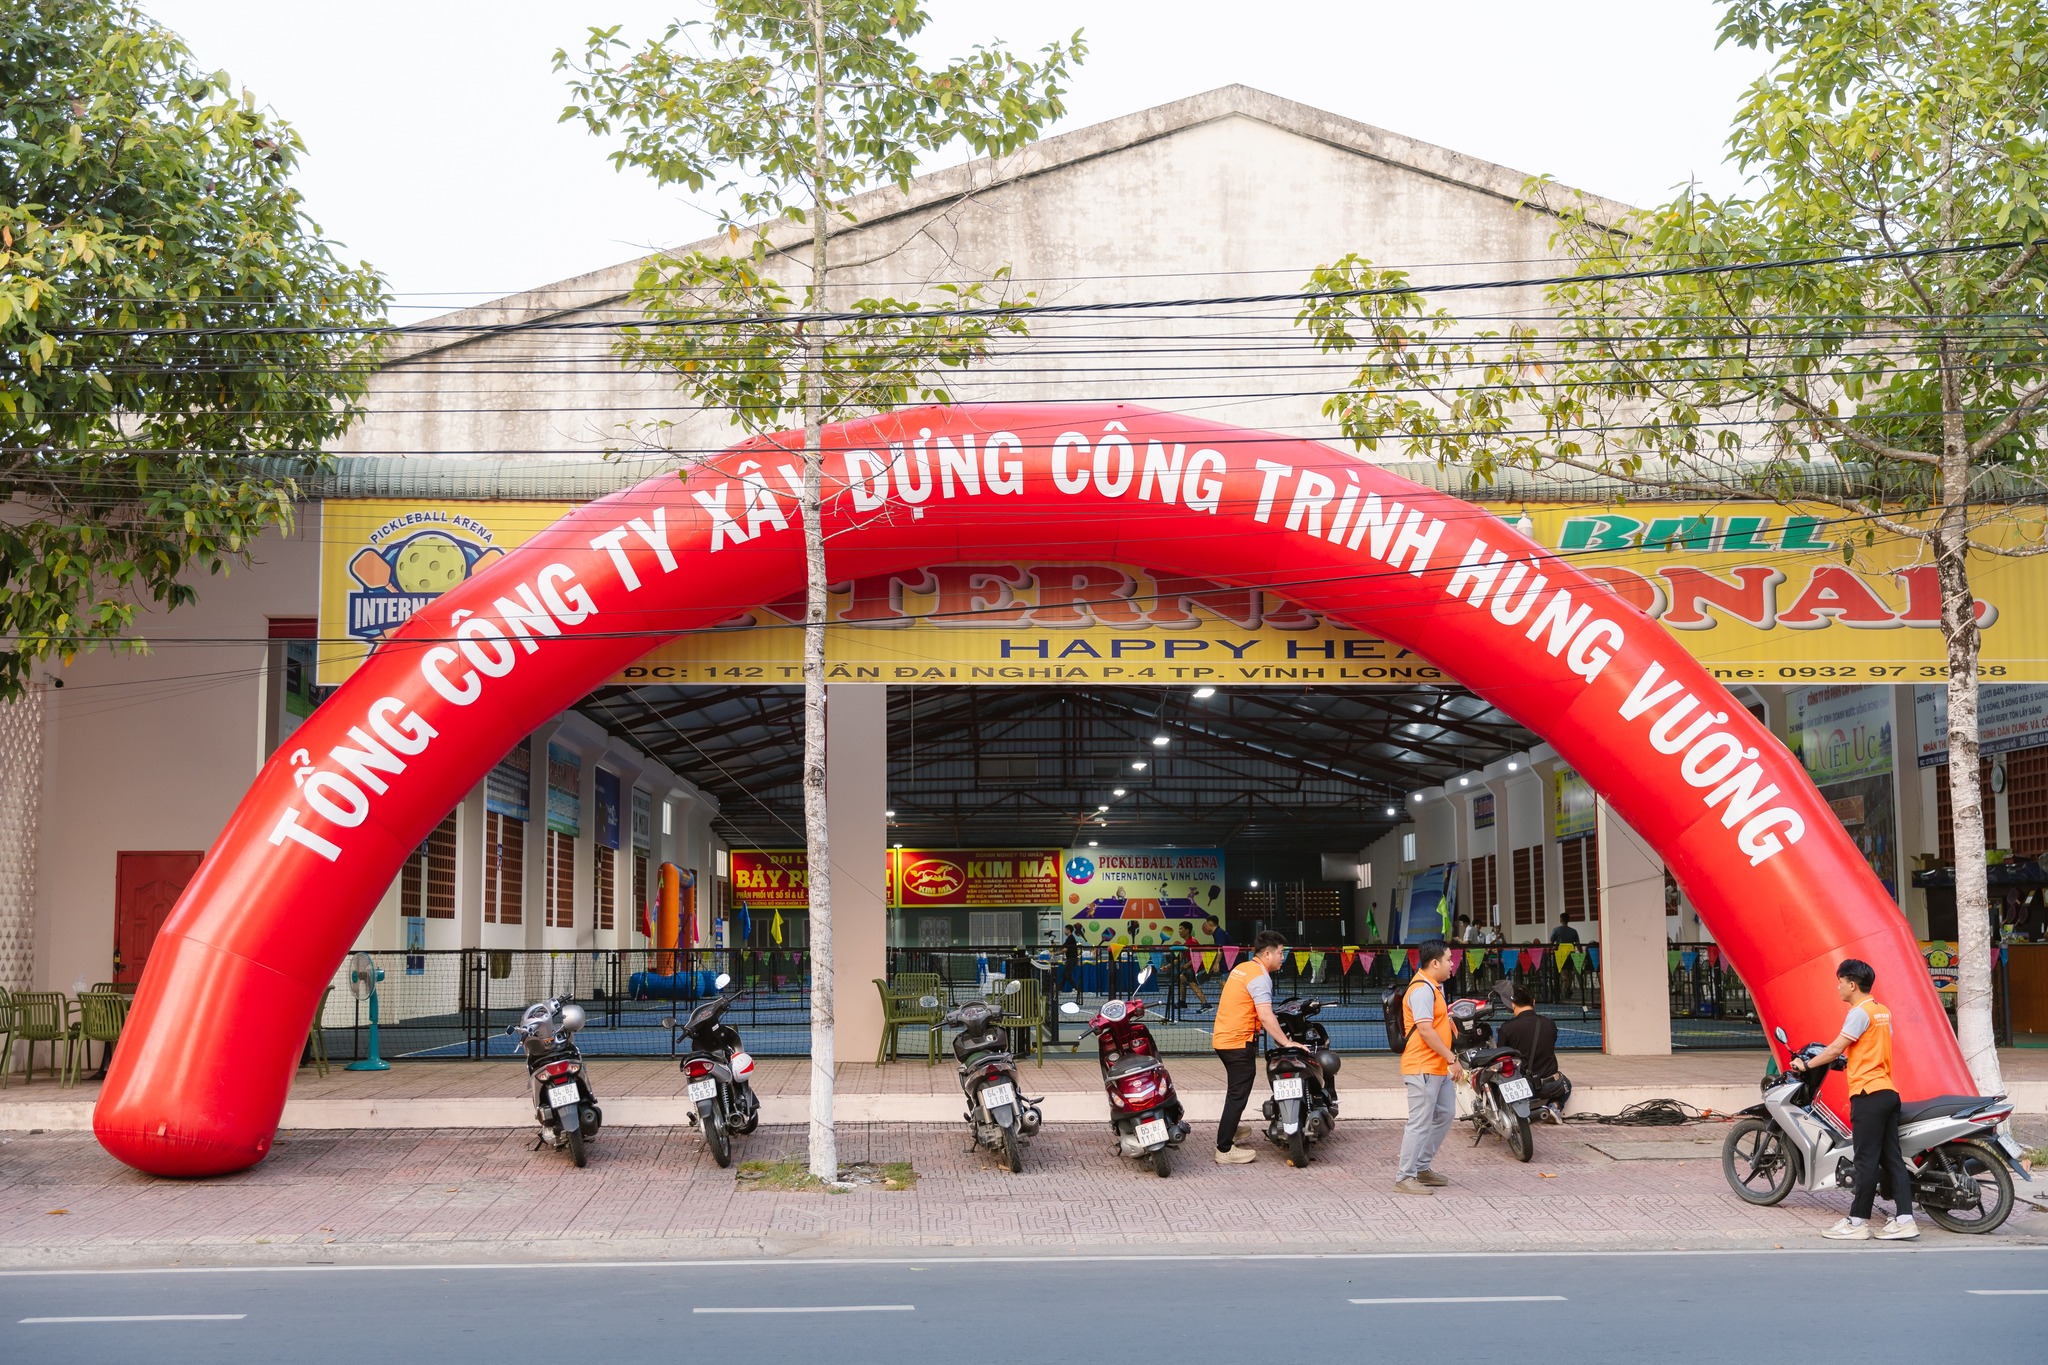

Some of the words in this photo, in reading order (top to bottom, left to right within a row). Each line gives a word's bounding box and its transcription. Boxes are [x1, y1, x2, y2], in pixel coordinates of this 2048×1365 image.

[370, 512, 448, 544] PICKLEBALL
[453, 515, 493, 543] ARENA
[1557, 514, 1839, 552] BALL
[354, 597, 436, 630] INTERN
[268, 697, 439, 862] TỔNG
[420, 563, 599, 706] CÔNG
[590, 506, 678, 592] TY
[844, 427, 1024, 518] DỰNG
[1051, 421, 1227, 515] CÔNG
[1253, 458, 1446, 578] TRÌNH
[1618, 660, 1805, 867] VƯƠNG
[1000, 639, 1261, 659] HAPPY
[623, 666, 687, 678] ĐC:
[704, 666, 764, 678] 142
[776, 662, 880, 678] TẦN
[894, 666, 956, 681] ĐẠI
[971, 664, 1089, 678] NGHĨA
[1103, 667, 1156, 678] P.4
[1168, 667, 1225, 678] TP.
[1238, 664, 1324, 678] VĨNH
[1339, 667, 1441, 678] LONG
[1778, 666, 1857, 678] 0932
[1870, 666, 1906, 678] 97
[967, 861, 1012, 878] KIM
[1019, 856, 1058, 878] MÃ
[1099, 855, 1173, 869] PICKLEBALL
[1176, 855, 1218, 869] ARENA
[736, 863, 783, 888] BẢY
[1102, 872, 1168, 881] INTERNATIONAL
[1170, 872, 1190, 881] VINH
[1193, 872, 1216, 881] LONG
[919, 886, 936, 894] KIM
